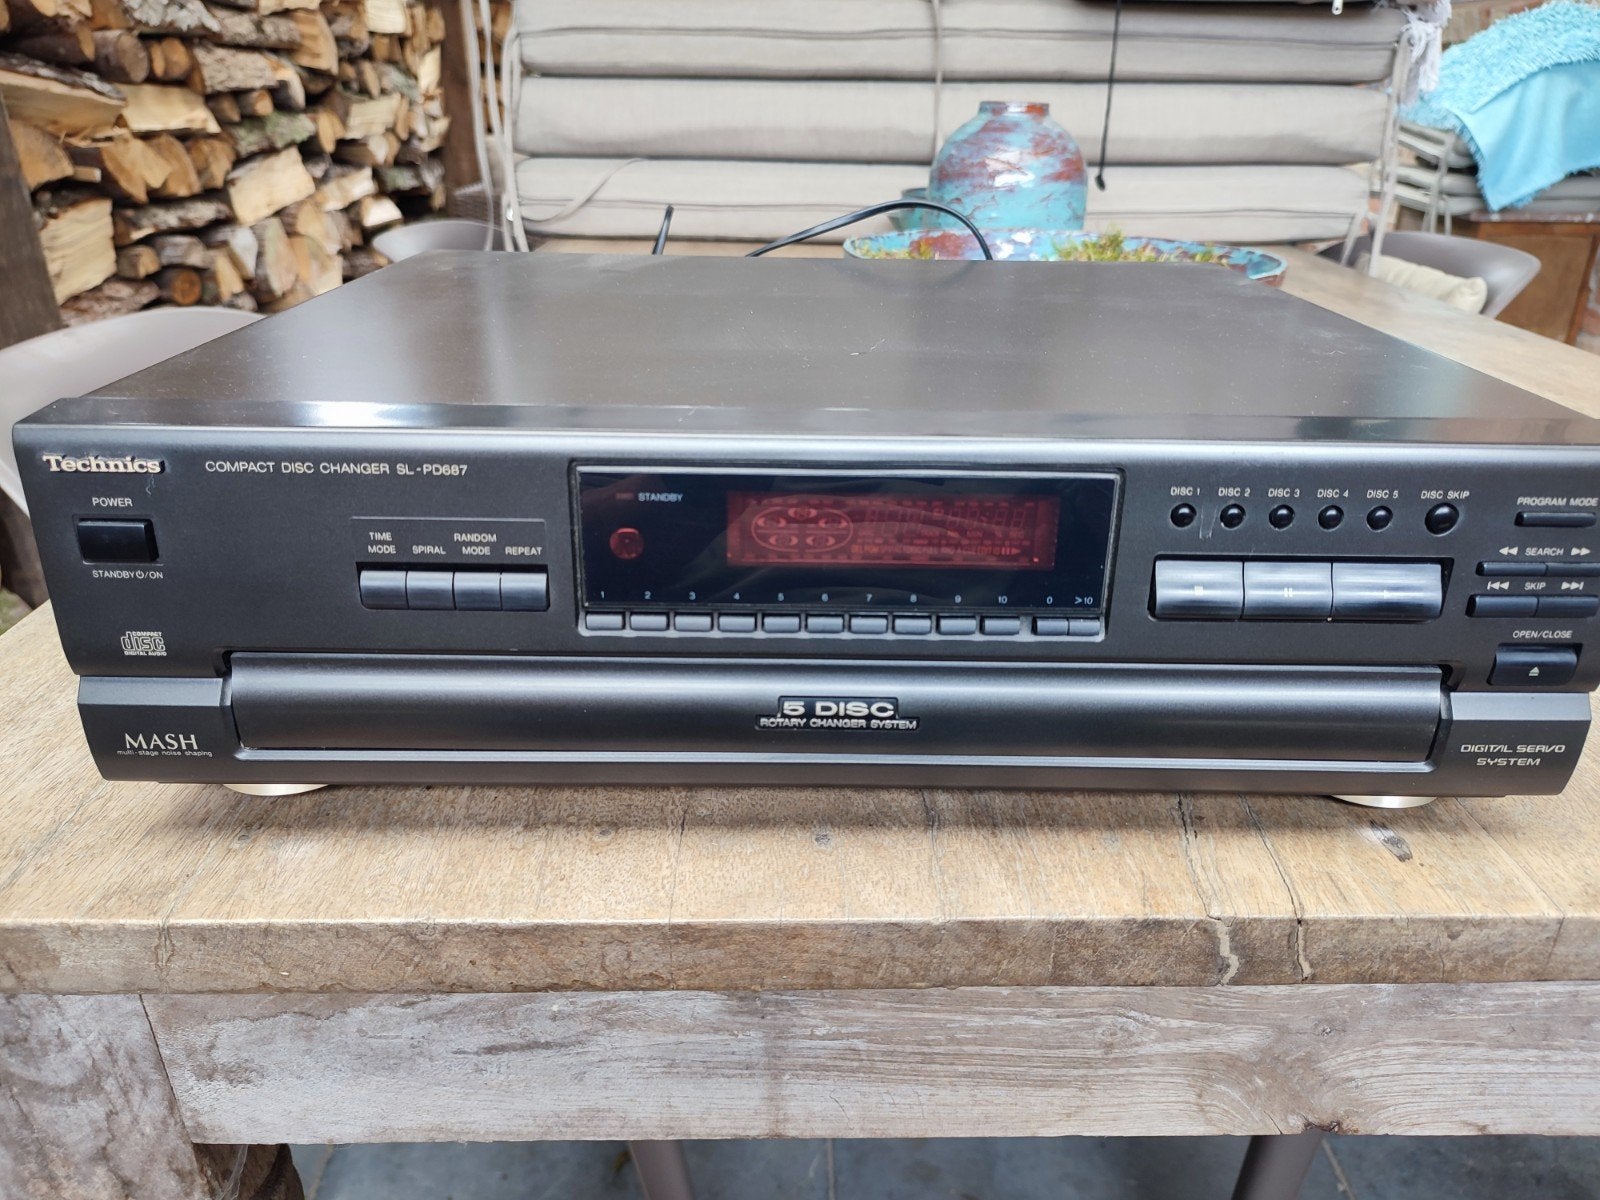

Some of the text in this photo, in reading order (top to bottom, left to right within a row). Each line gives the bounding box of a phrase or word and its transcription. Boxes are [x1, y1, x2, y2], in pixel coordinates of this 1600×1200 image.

[43, 454, 162, 475] Technics
[204, 460, 275, 474] COMPACT
[281, 461, 315, 475] DISC
[319, 462, 390, 475] CHANGER
[637, 492, 684, 502] STANDBY
[1170, 486, 1201, 497] DISC 1
[1218, 486, 1250, 498] DISC 2
[1267, 487, 1300, 498] DISC 3
[1316, 488, 1349, 498] DISC 4
[1366, 489, 1399, 500] DISC 5
[1420, 490, 1470, 500] DISC SKIP
[92, 497, 134, 507] POWER
[1516, 496, 1599, 507] PROGRAM MODE
[368, 532, 393, 542] TIME
[453, 532, 498, 543] RANDOM
[367, 544, 397, 555] MODE
[412, 545, 446, 555] SPIRAL
[462, 545, 491, 556] MODE
[504, 546, 543, 556] REPEAT
[1524, 547, 1565, 556] SEARCH
[1524, 581, 1547, 591] SKIP
[600, 590, 605, 599] 1
[644, 590, 652, 599] 2
[688, 591, 696, 600] 3
[733, 592, 740, 600] 4
[777, 592, 785, 601] 5
[821, 593, 829, 602] 6
[866, 593, 873, 602] 7
[910, 594, 918, 603] 8
[954, 594, 962, 603] 9
[997, 595, 1008, 604] 10
[1046, 595, 1053, 604] 0
[1512, 630, 1573, 639] OPEN/CLOSE
[783, 701, 895, 718] 5 DISC
[760, 718, 917, 730] ROTARY CHANGER SYSTEM
[124, 733, 199, 750] MASH
[184, 750, 213, 758] shaping
[1460, 744, 1566, 753] DIGITAL SERVO
[1476, 757, 1541, 766] SYSTEM
